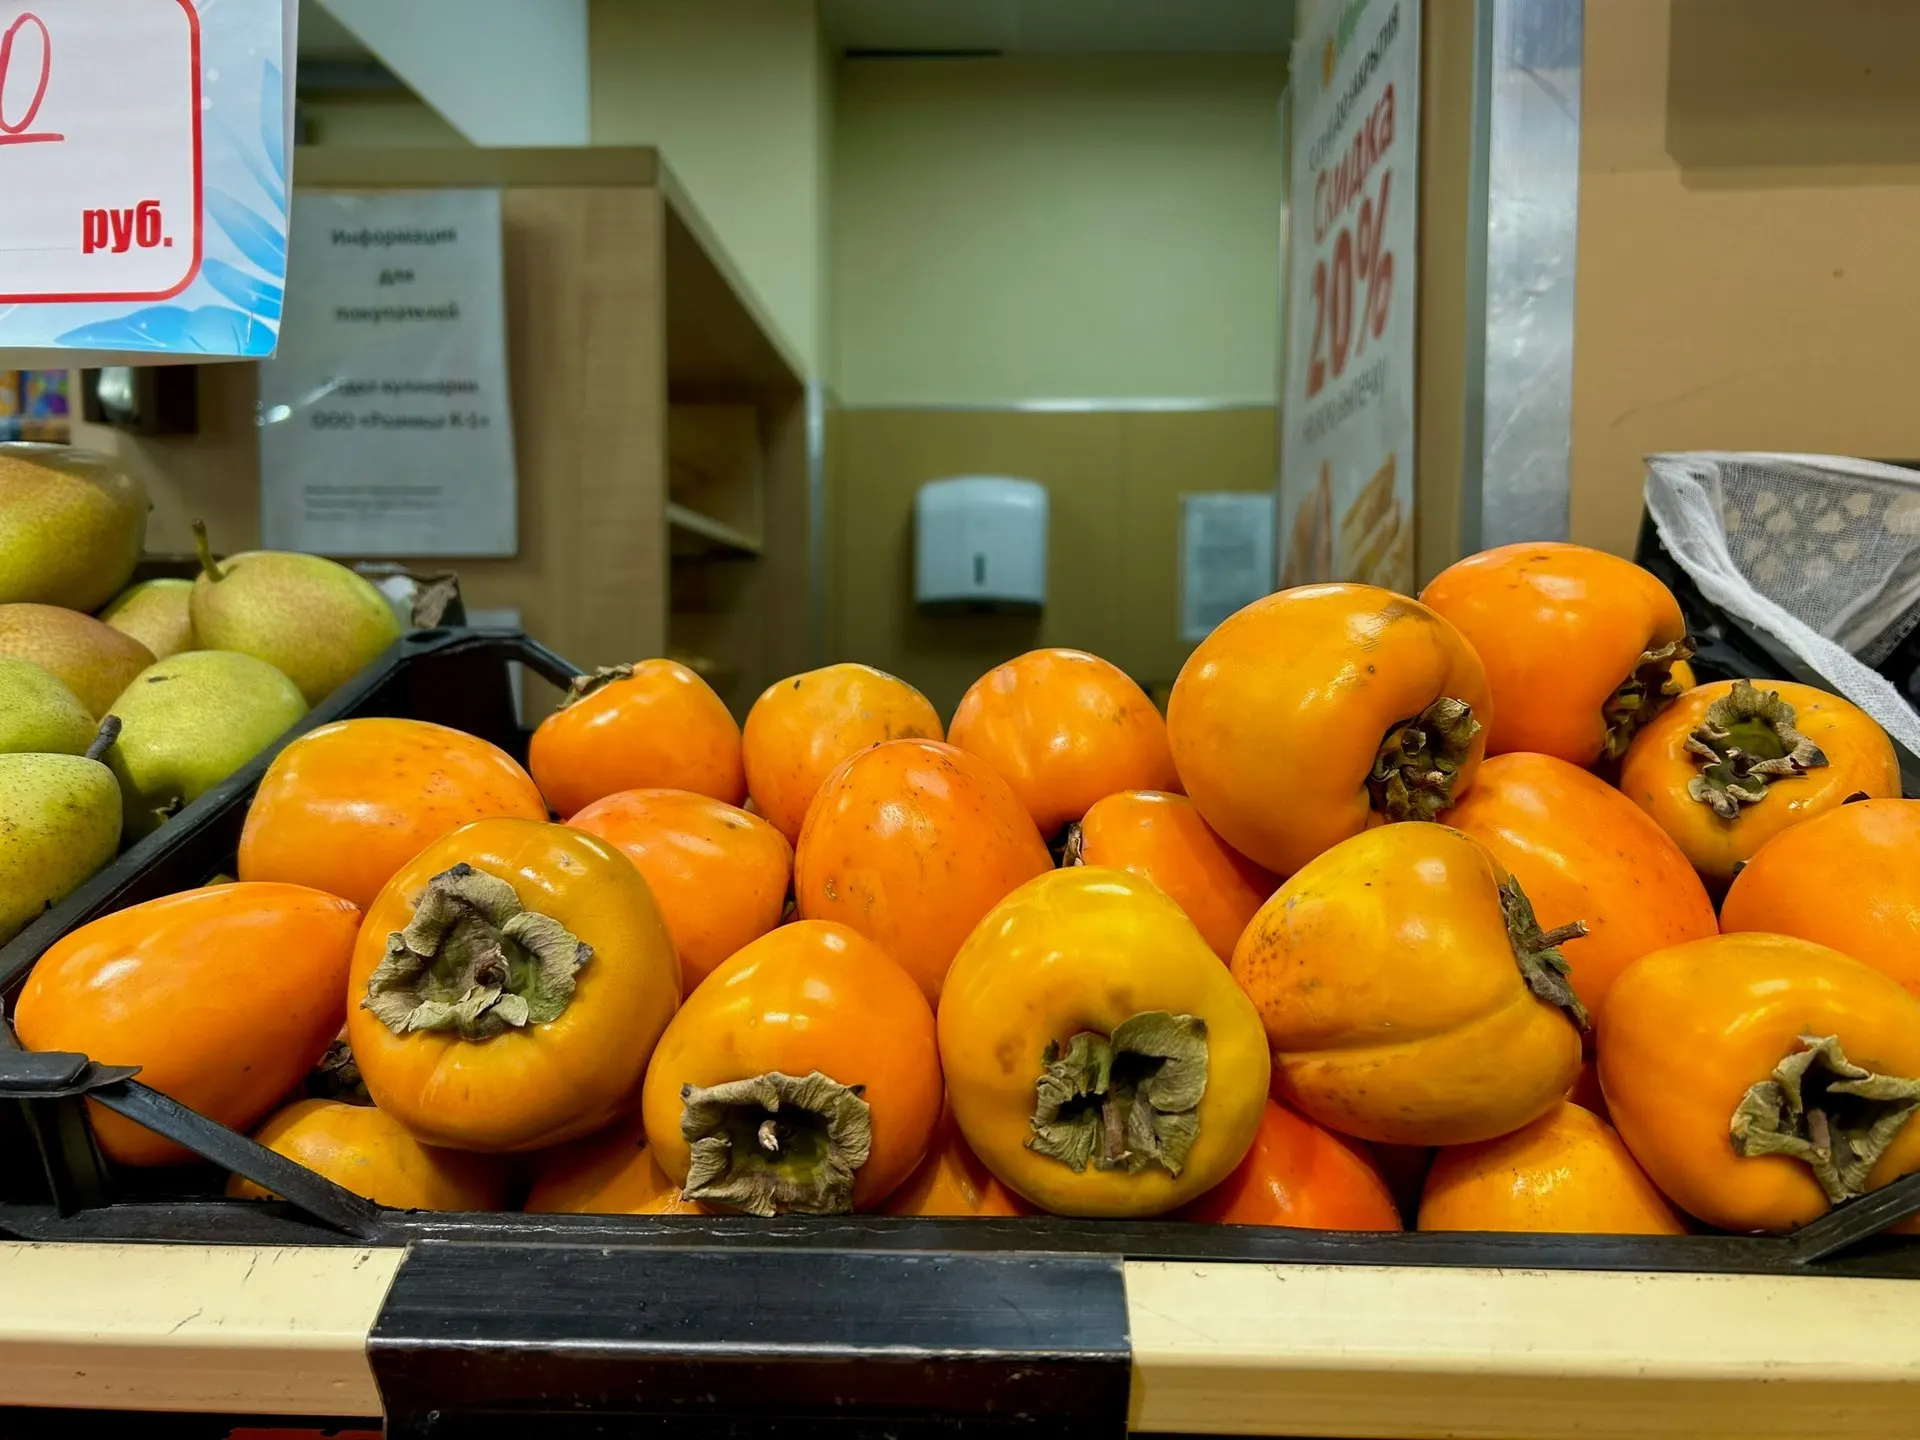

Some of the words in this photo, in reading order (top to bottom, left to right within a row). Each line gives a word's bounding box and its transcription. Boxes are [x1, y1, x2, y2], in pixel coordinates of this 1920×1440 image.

[82, 200, 173, 254] руб.
[331, 226, 457, 248] Информация
[1306, 168, 1393, 399] 20%
